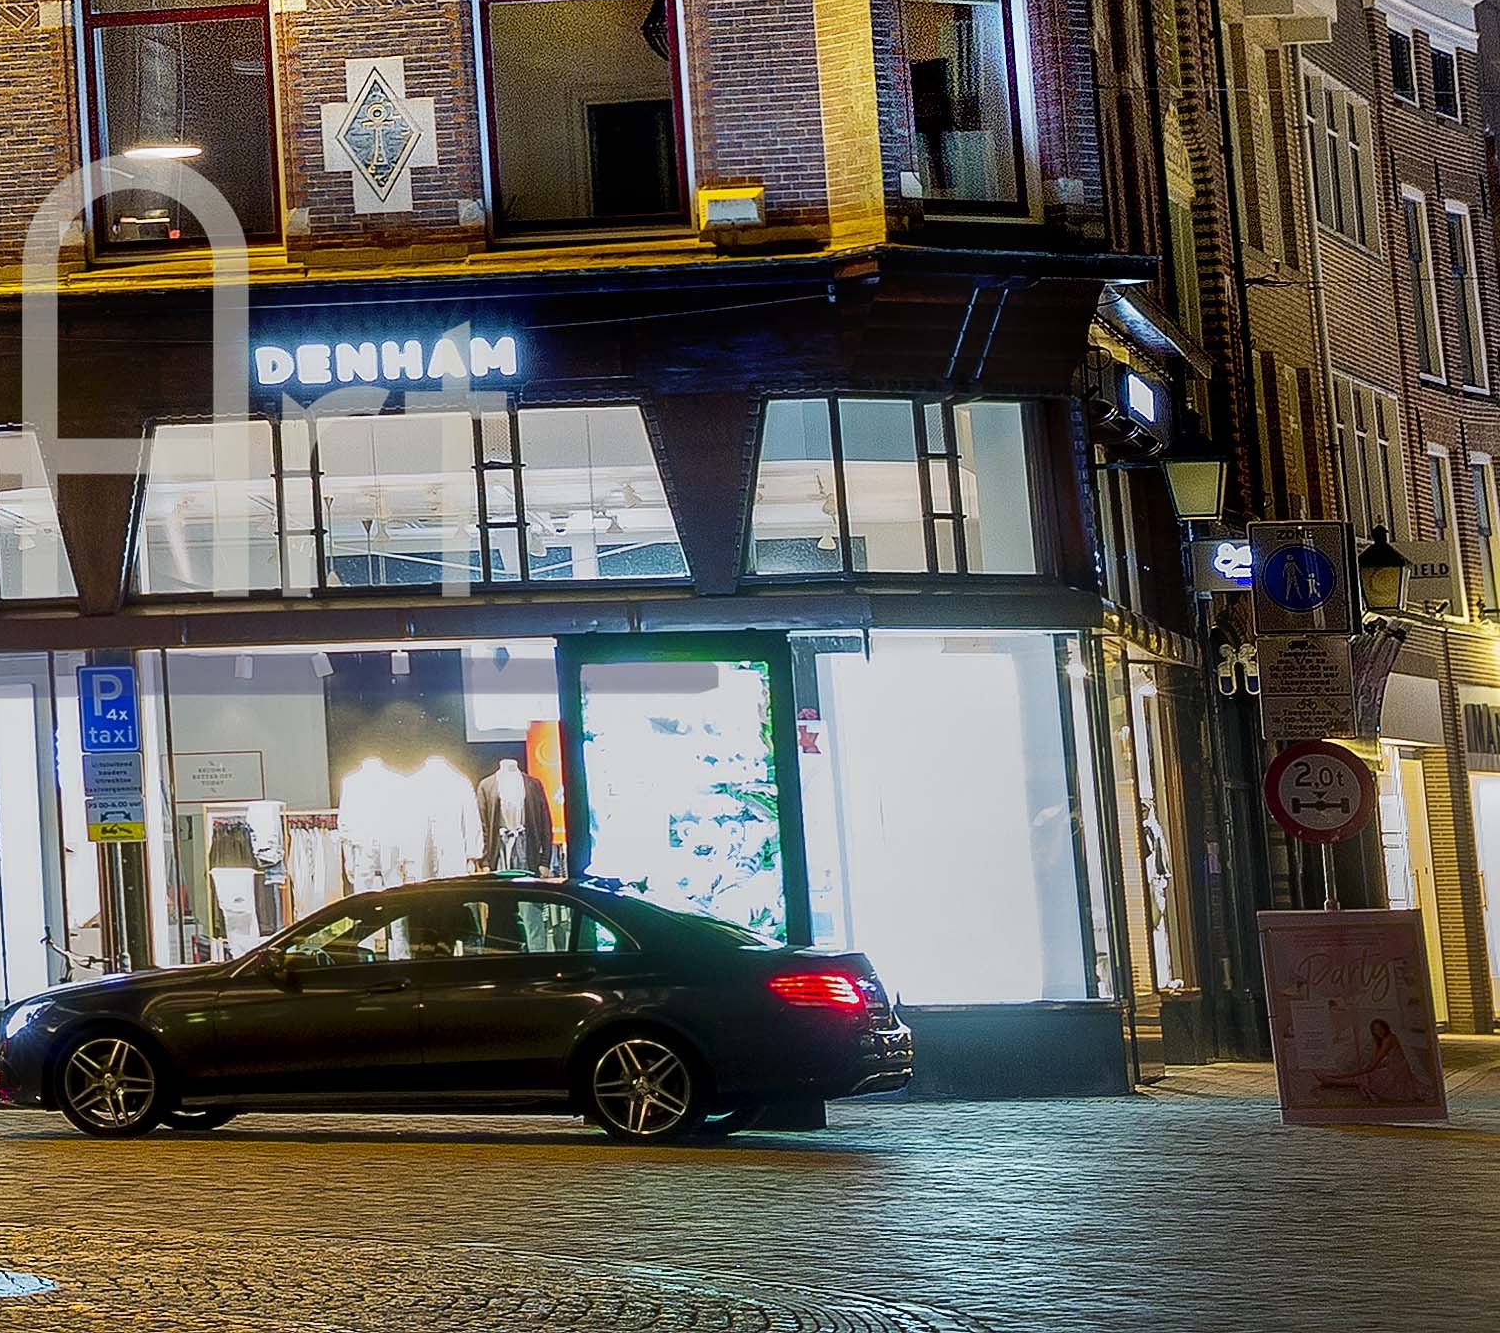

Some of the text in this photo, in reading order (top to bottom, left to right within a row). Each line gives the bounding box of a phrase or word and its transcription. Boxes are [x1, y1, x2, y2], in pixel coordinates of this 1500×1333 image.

[254, 335, 518, 386] DENHAM
[92, 674, 124, 717] P
[106, 708, 130, 722] 4x
[88, 725, 134, 745] taxi
